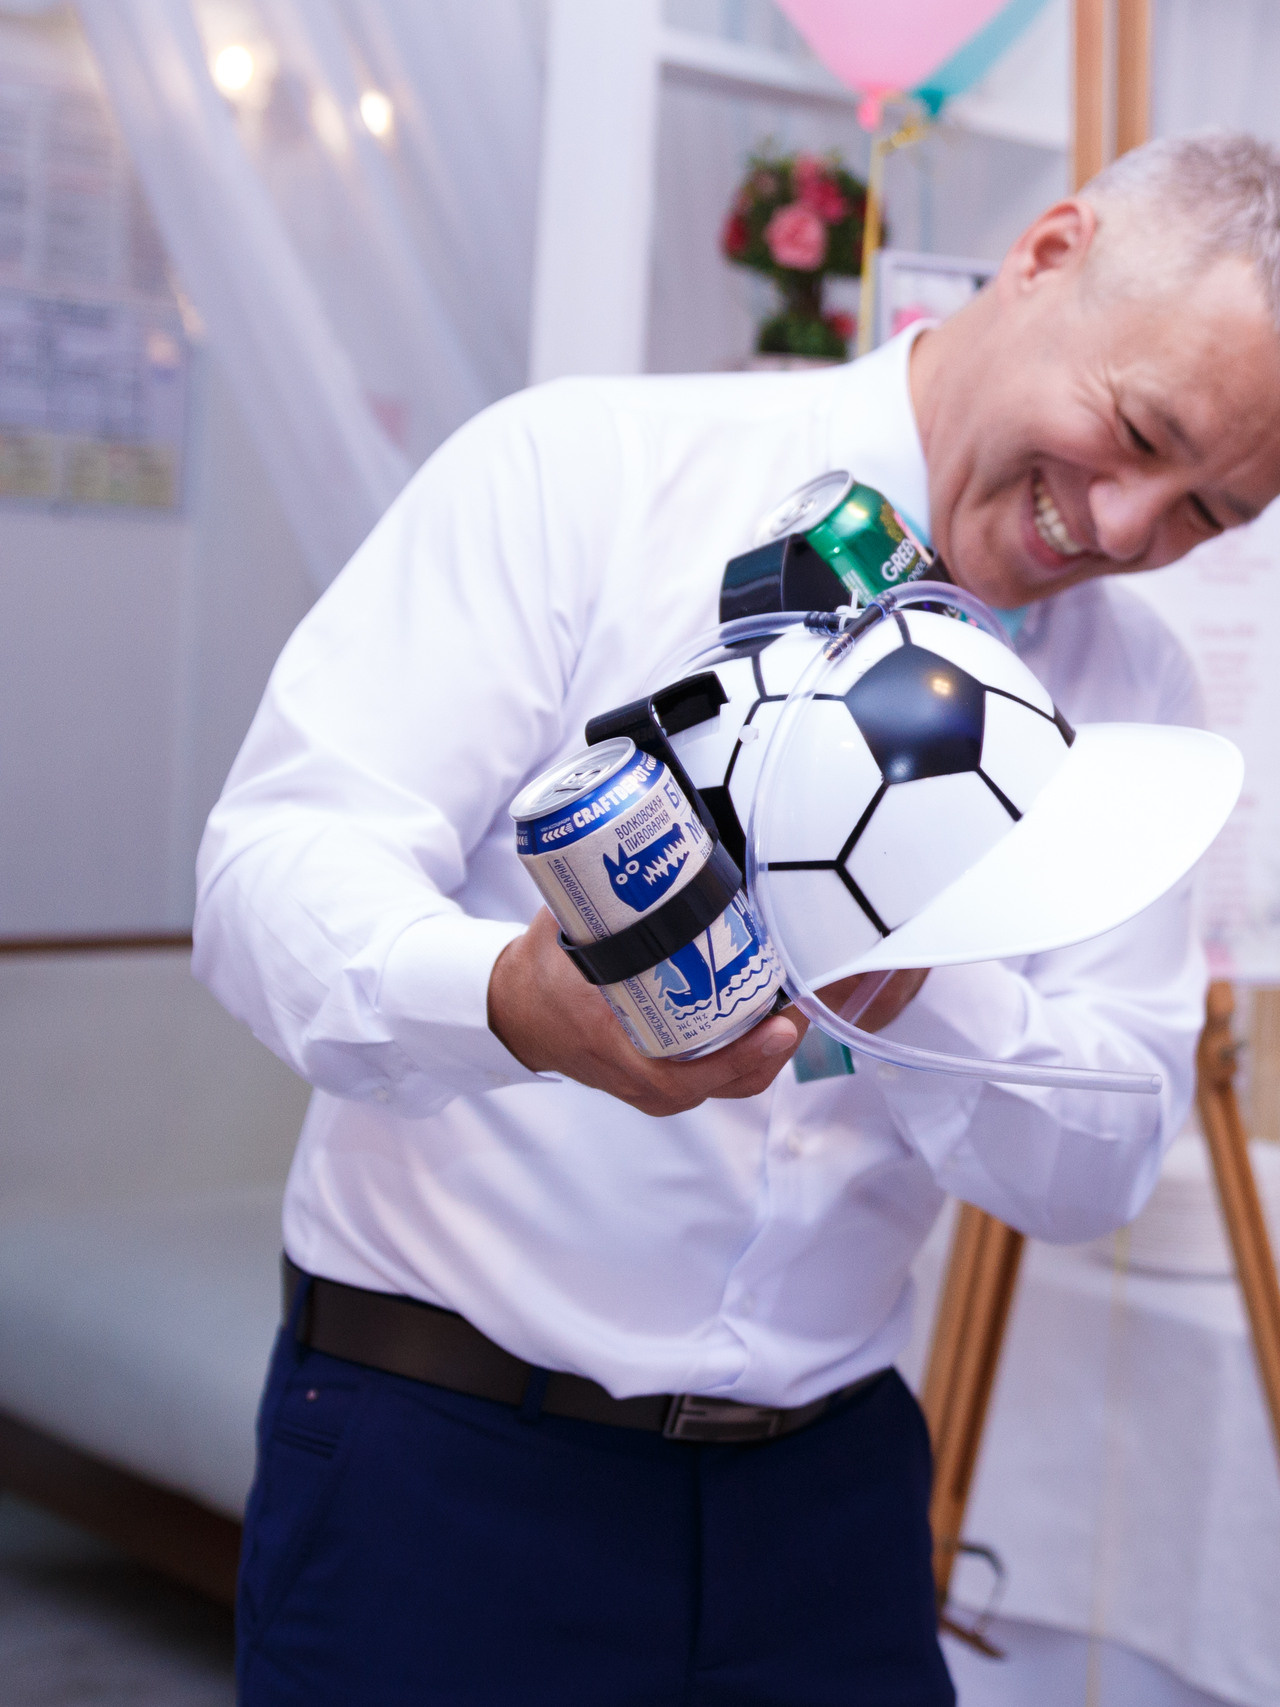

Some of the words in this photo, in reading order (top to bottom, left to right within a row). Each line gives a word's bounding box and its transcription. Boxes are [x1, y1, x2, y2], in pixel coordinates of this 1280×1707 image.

[573, 764, 651, 828] CRAFTDEPOT
[614, 795, 664, 840] ВОЛКОВСКАЯ
[624, 809, 671, 852] ПИВОВАРНЯ
[642, 1005, 674, 1048] ТВОРЧЕСКАЯ
